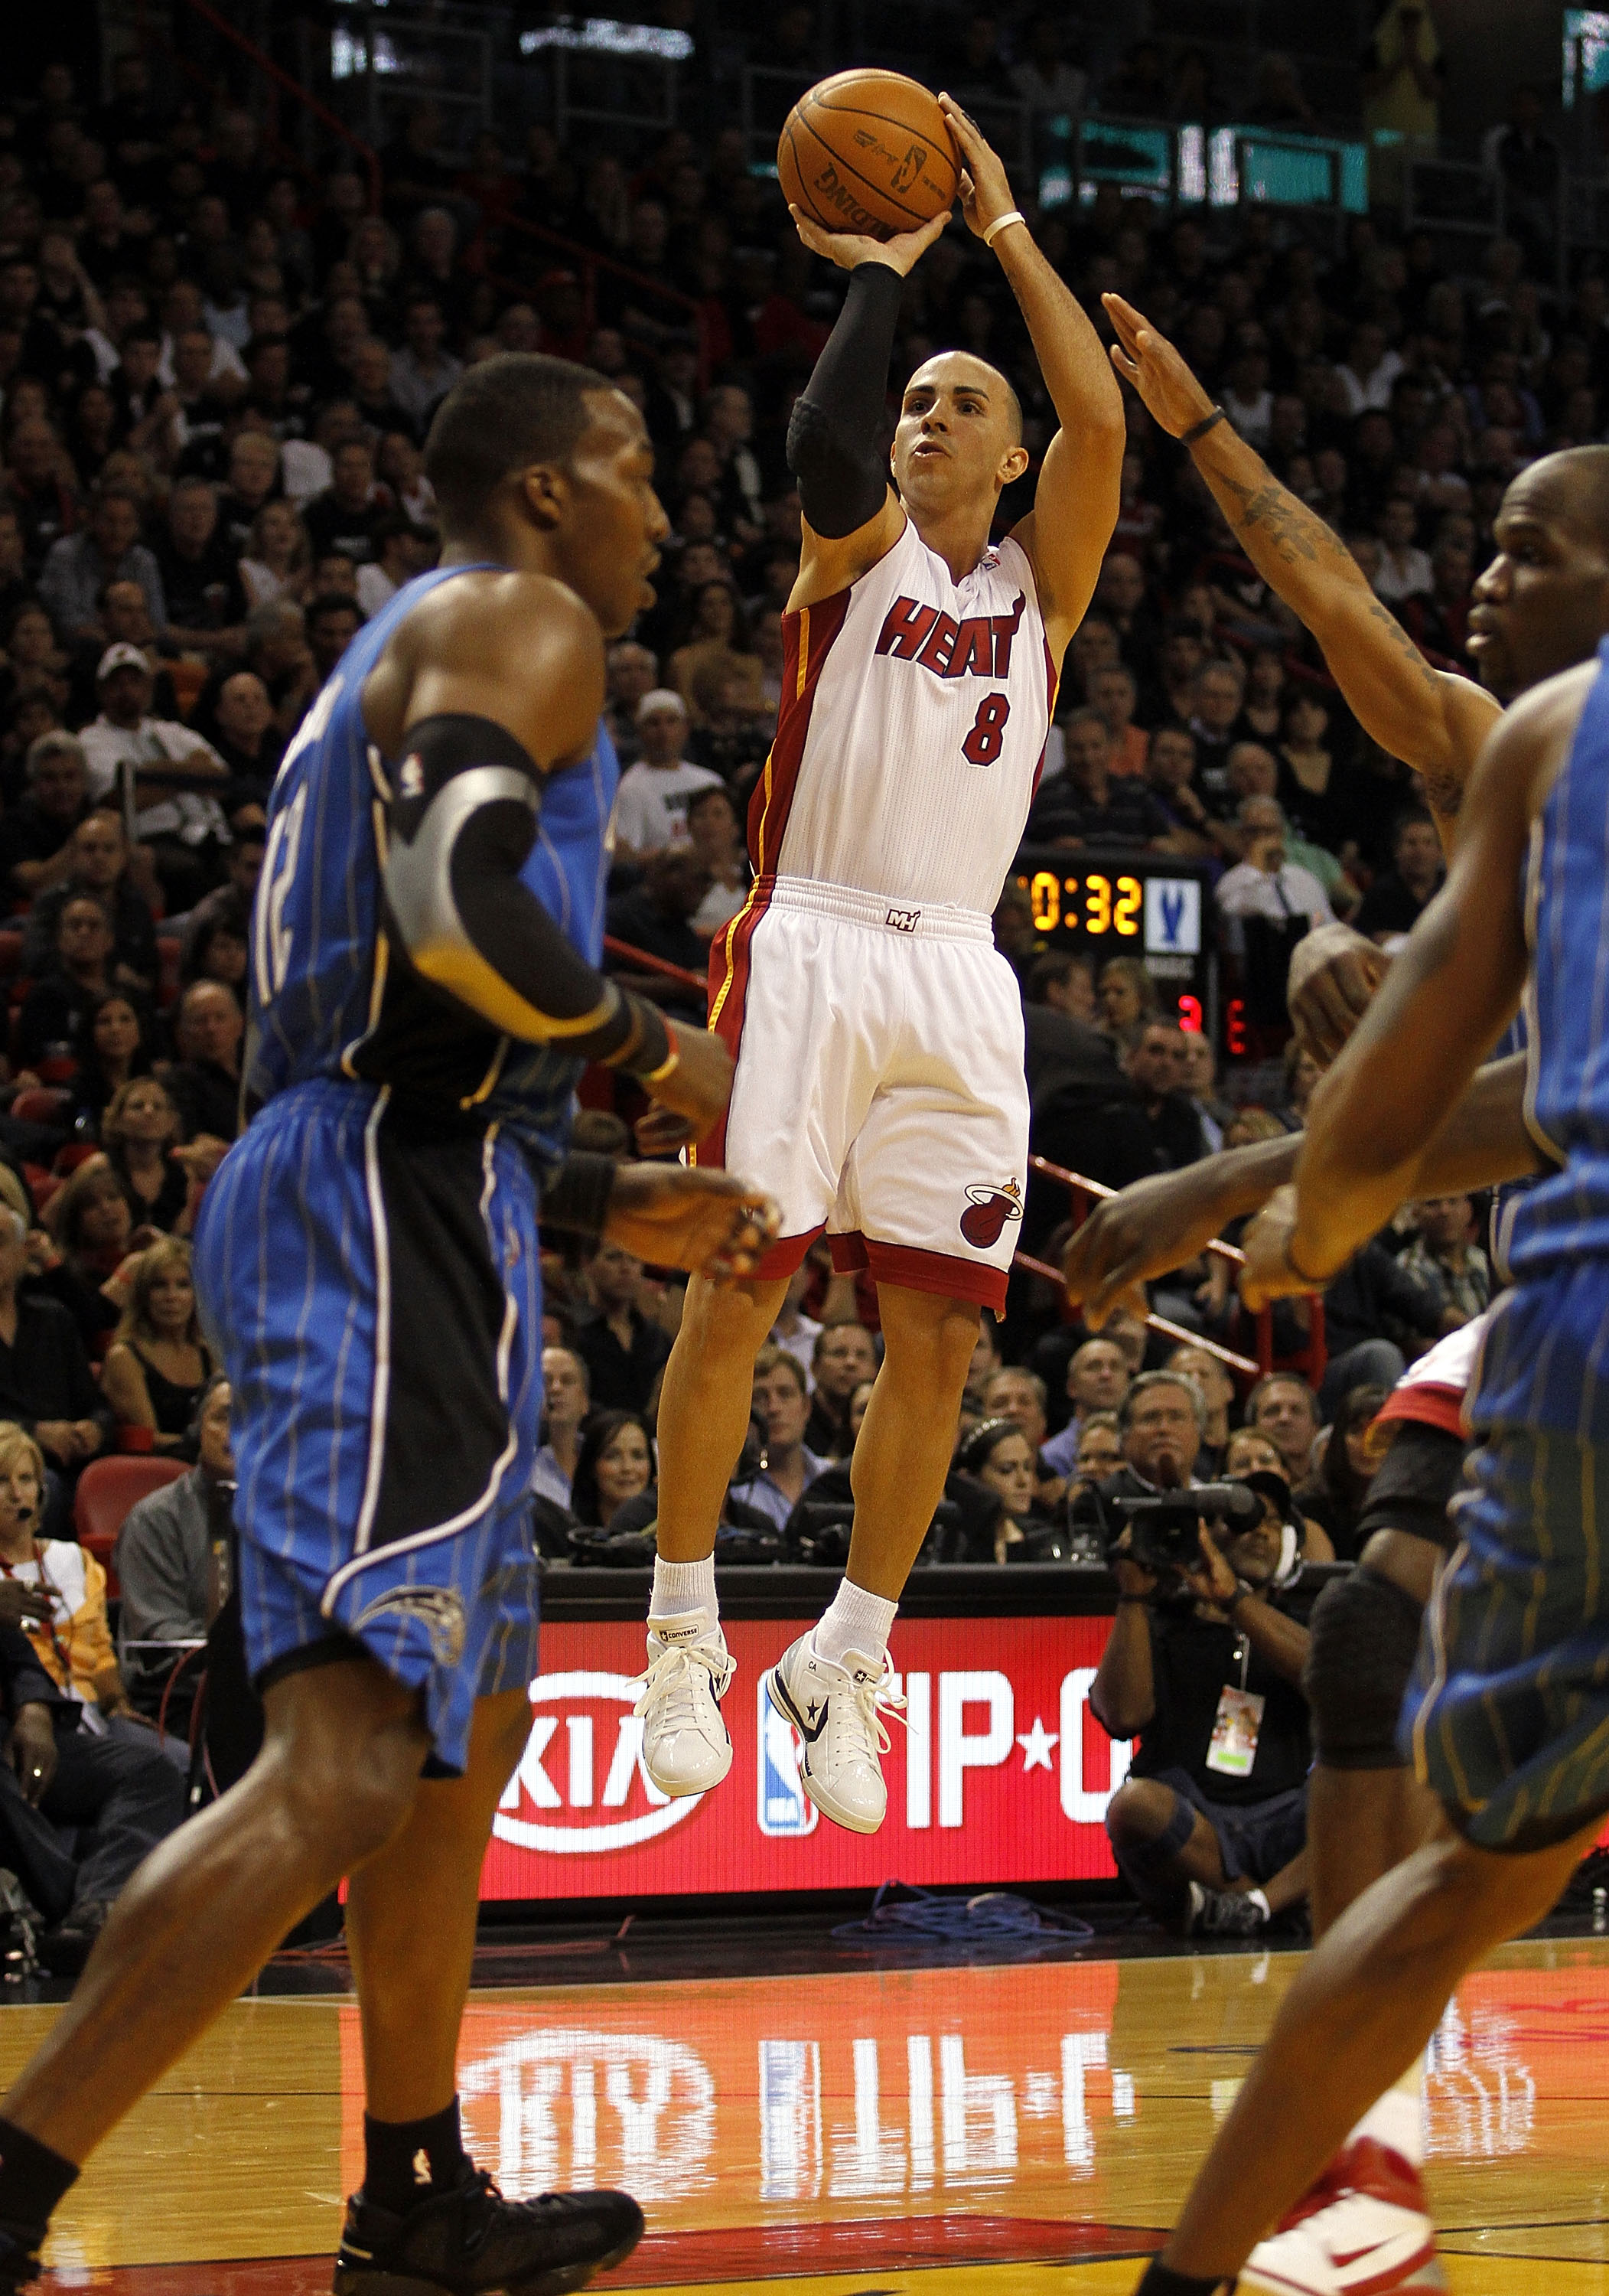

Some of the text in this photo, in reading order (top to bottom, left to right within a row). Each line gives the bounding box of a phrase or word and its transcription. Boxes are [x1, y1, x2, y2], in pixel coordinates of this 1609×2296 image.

[875, 589, 1026, 680] HEAT
[961, 691, 1011, 768] 8
[667, 1626, 699, 1639] CONVERSE
[807, 1660, 817, 1672] CA
[498, 1714, 671, 1808] KIA
